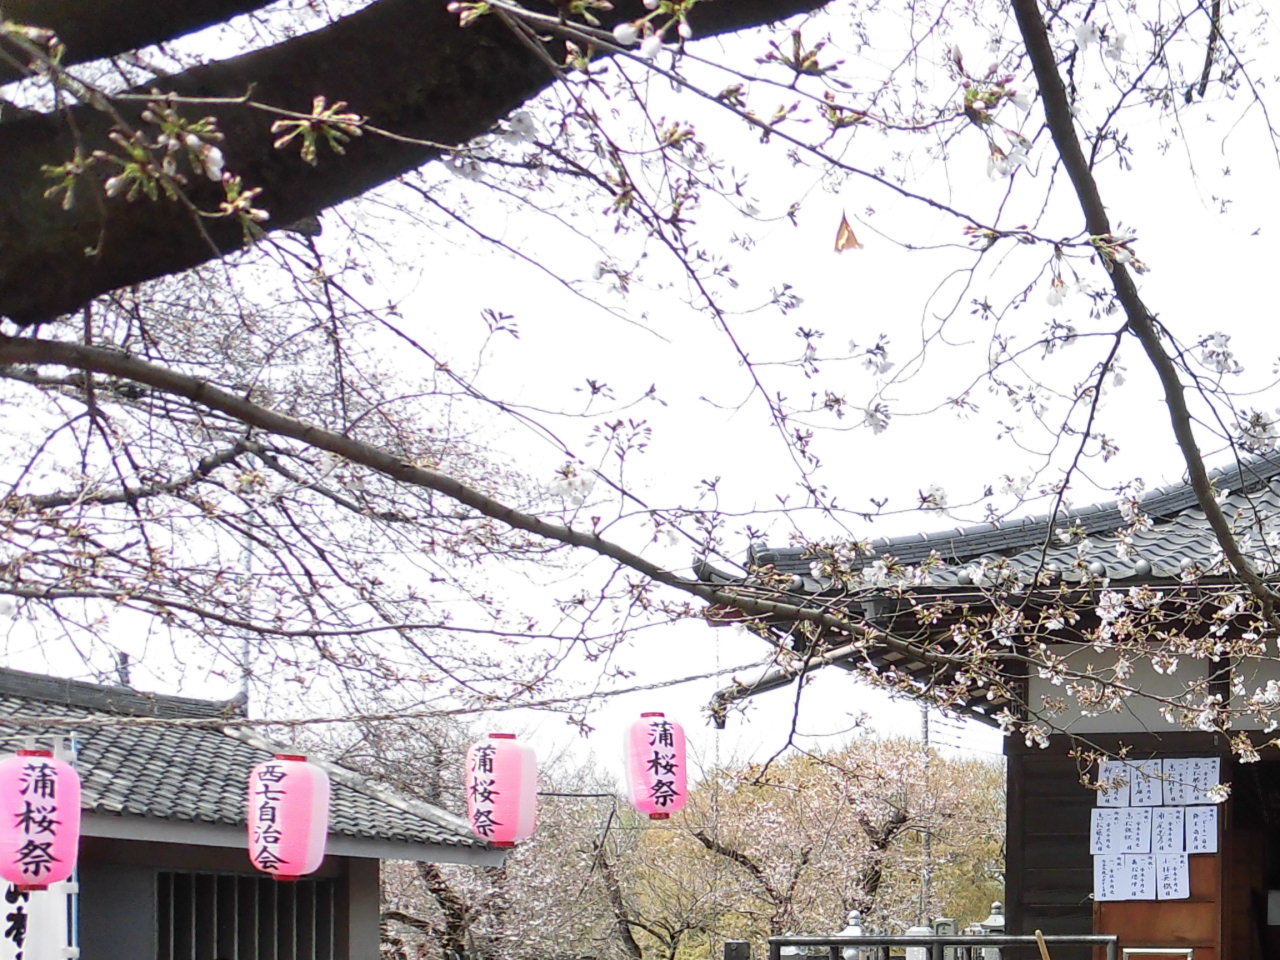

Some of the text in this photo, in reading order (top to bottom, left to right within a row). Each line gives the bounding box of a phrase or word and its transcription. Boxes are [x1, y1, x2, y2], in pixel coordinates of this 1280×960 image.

[470, 744, 503, 837] 蒲桜祭
[647, 721, 681, 807] 蒲桜祭
[13, 763, 62, 877] 蒲桜祭
[254, 765, 289, 870] 西七自治会
